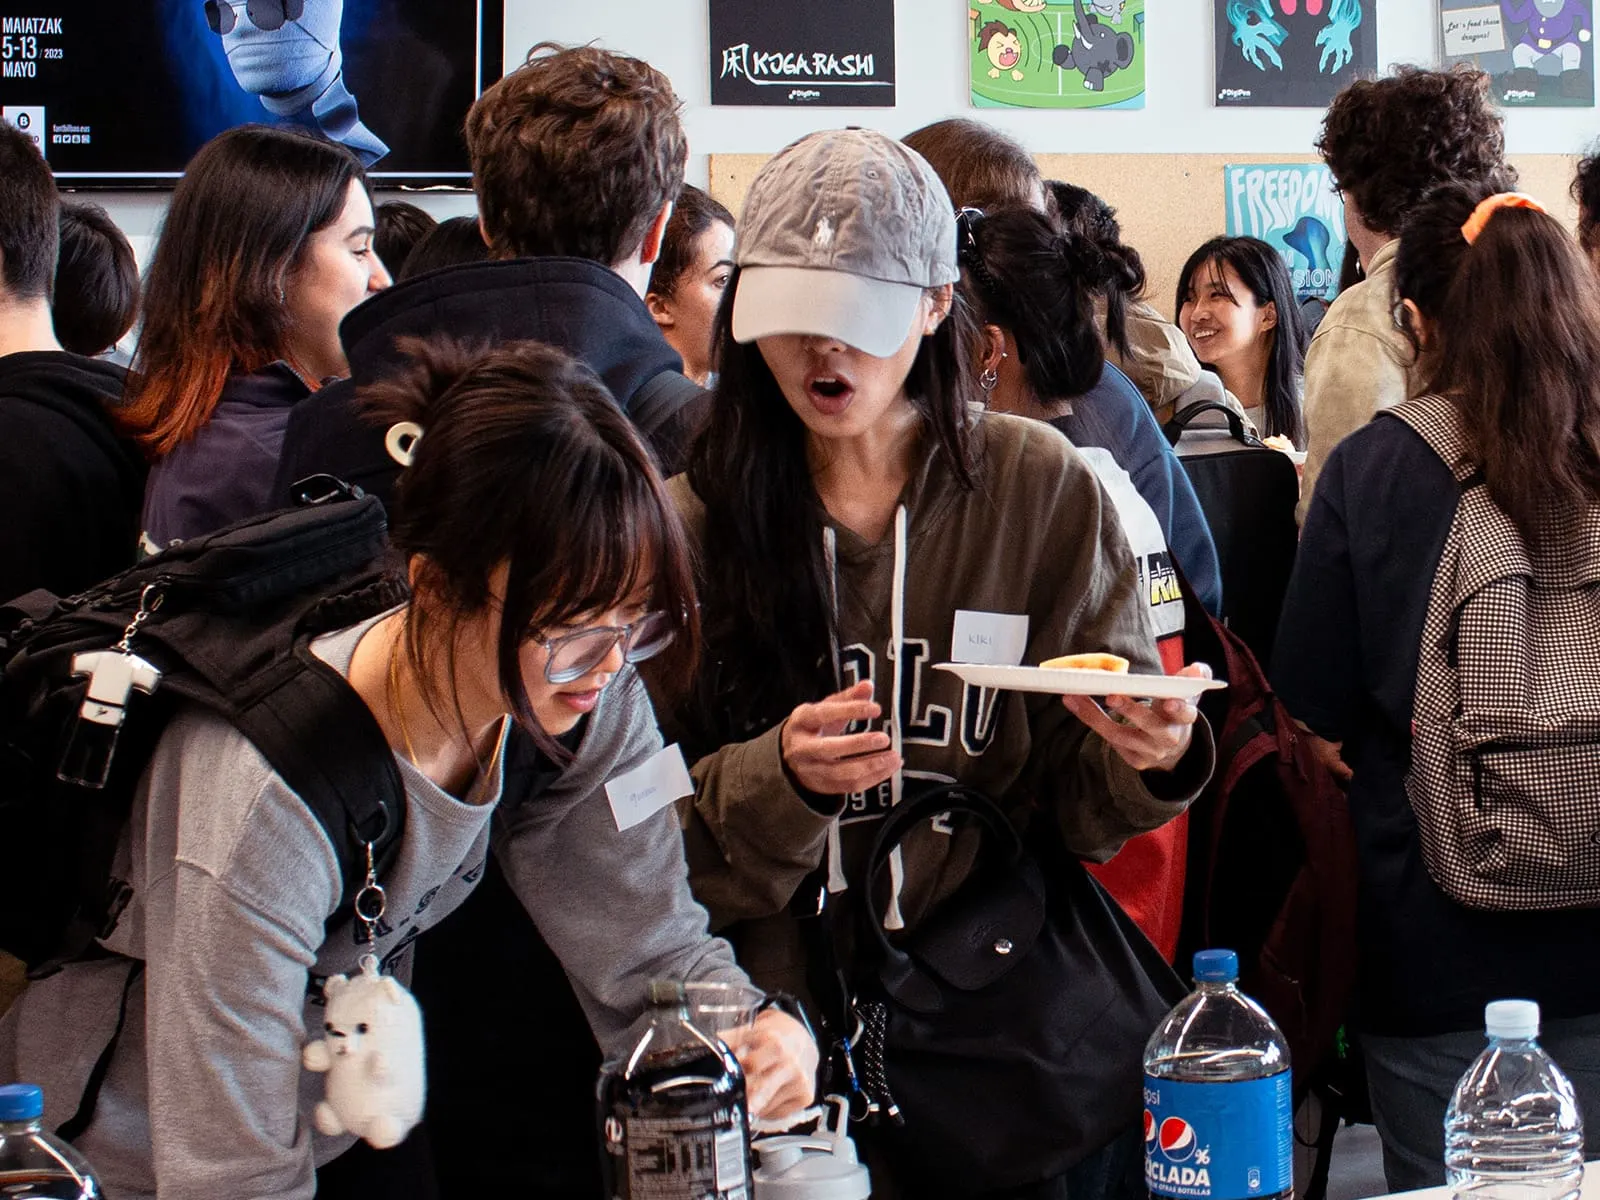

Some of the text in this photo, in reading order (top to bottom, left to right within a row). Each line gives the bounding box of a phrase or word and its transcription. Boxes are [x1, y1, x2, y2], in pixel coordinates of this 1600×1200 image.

[3, 17, 63, 34] MAIATZAK
[2, 36, 37, 59] 5-13
[44, 48, 63, 59] 2023
[3, 61, 36, 78] MAYO
